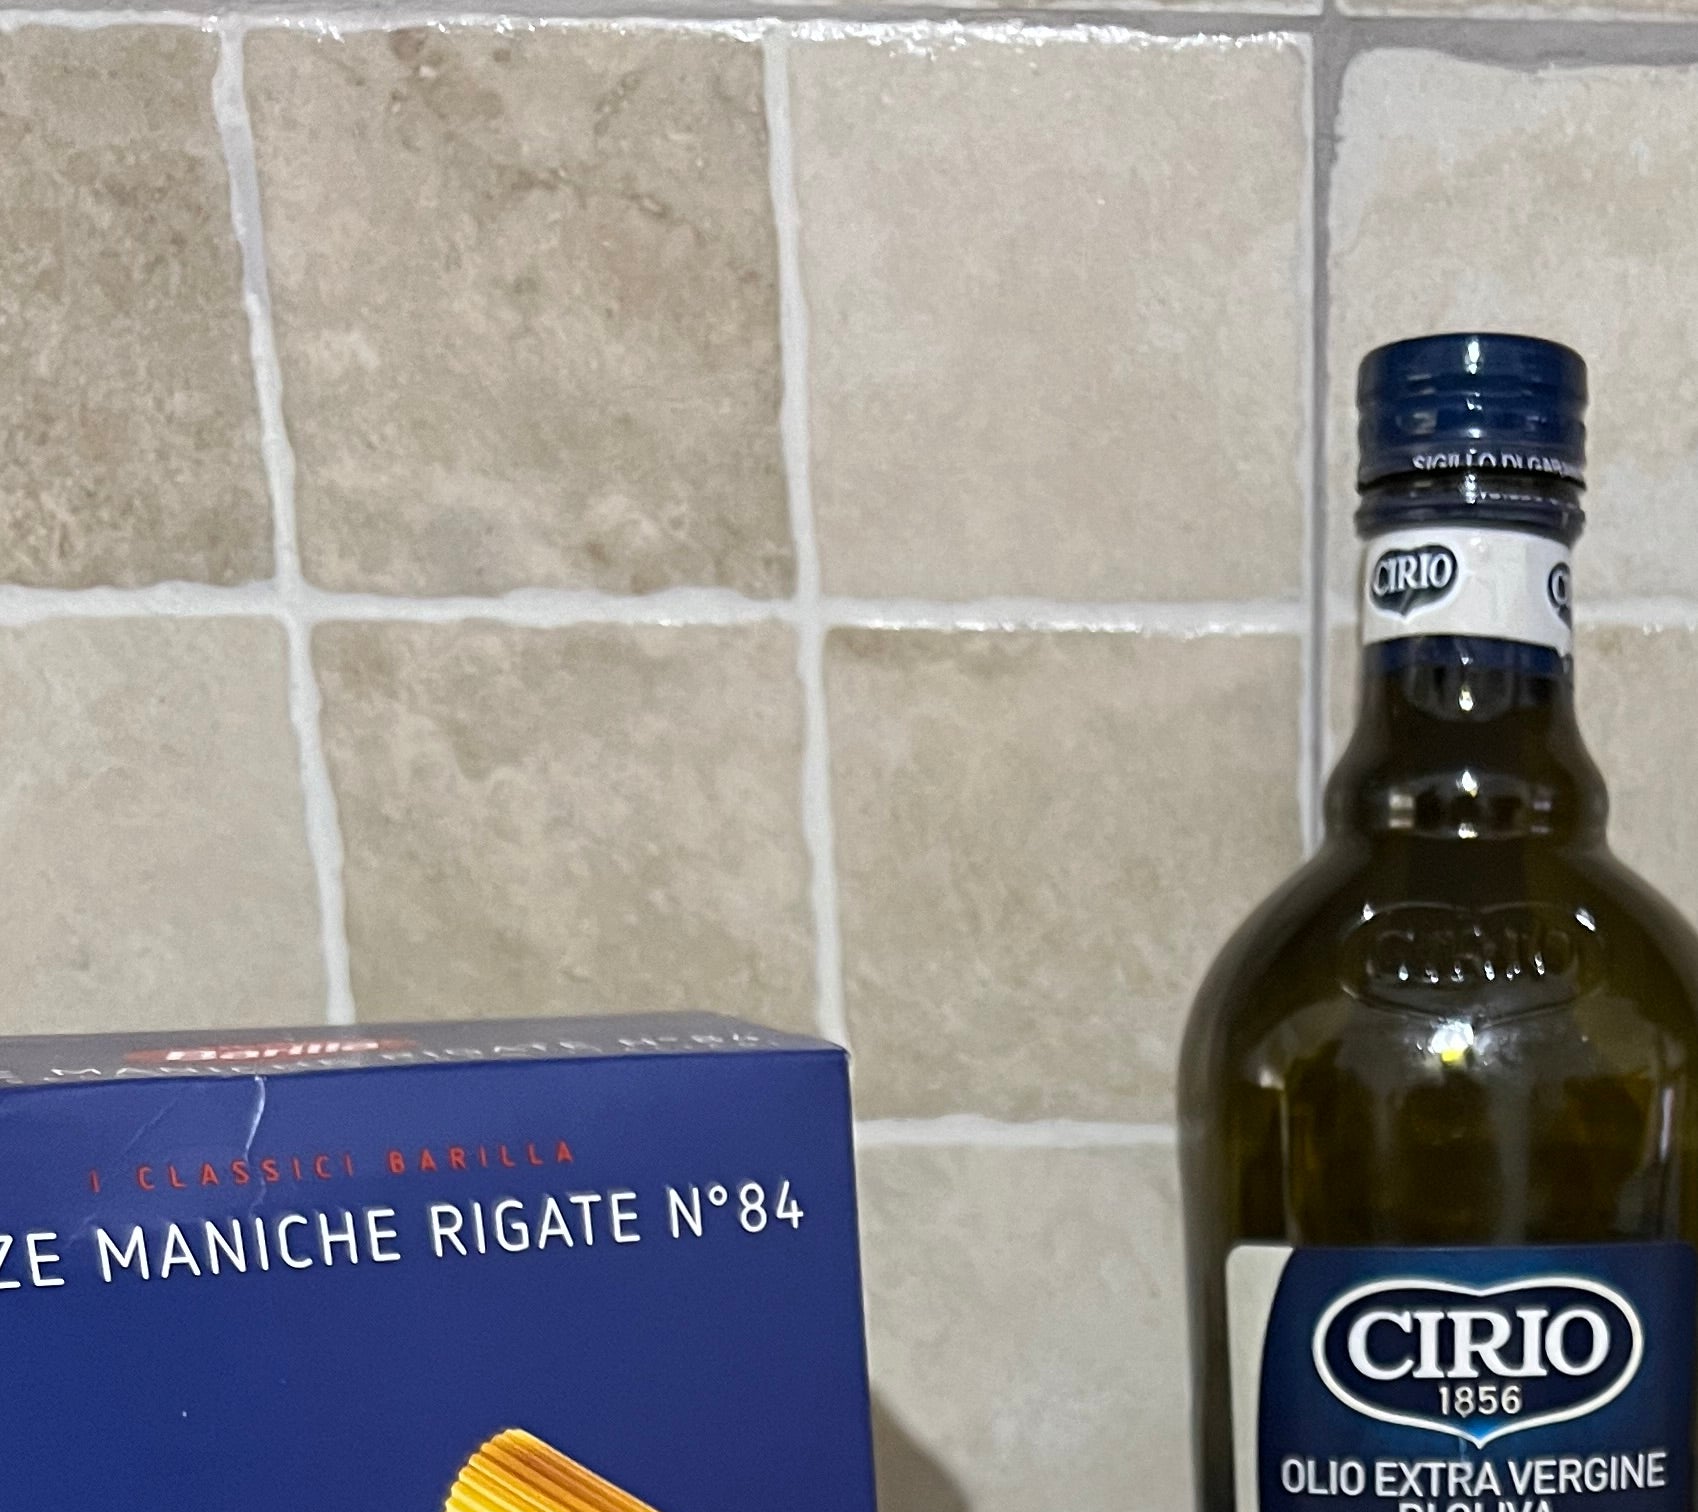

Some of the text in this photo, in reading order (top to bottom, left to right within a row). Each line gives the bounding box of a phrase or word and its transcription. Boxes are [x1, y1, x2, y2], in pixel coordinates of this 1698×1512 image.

[1373, 552, 1453, 596] CIRIO
[90, 1141, 575, 1193] I CLASSICI BARILLA
[97, 1208, 401, 1283] MANICHE
[429, 1191, 641, 1258] RIGATE
[1347, 1308, 1610, 1381] CIRIO
[1439, 1385, 1522, 1416] 1856
[1281, 1451, 1667, 1498] OLIO EXTRA VERGINE
